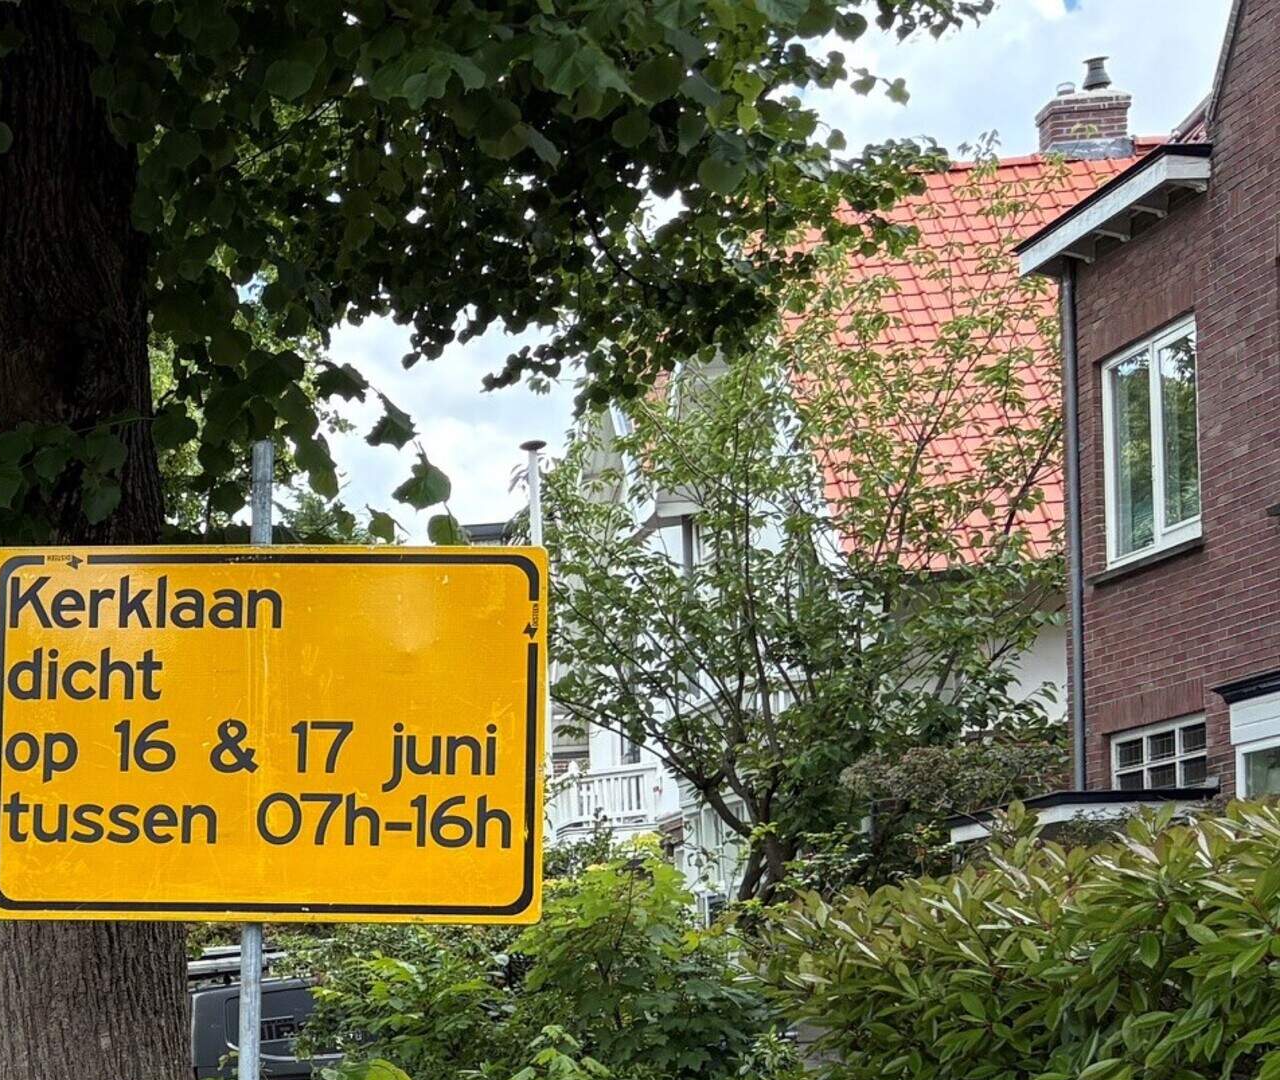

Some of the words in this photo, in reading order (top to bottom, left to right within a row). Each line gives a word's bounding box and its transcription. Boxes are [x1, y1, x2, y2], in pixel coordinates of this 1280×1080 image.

[8, 574, 283, 630] Kerklaan
[6, 646, 163, 701] dicht
[5, 731, 79, 784] op
[114, 718, 177, 774] 16
[209, 717, 260, 775] &
[291, 720, 355, 775] 17
[382, 721, 498, 794] juni
[3, 791, 218, 845] tussen
[256, 791, 513, 850] 07h-16h
